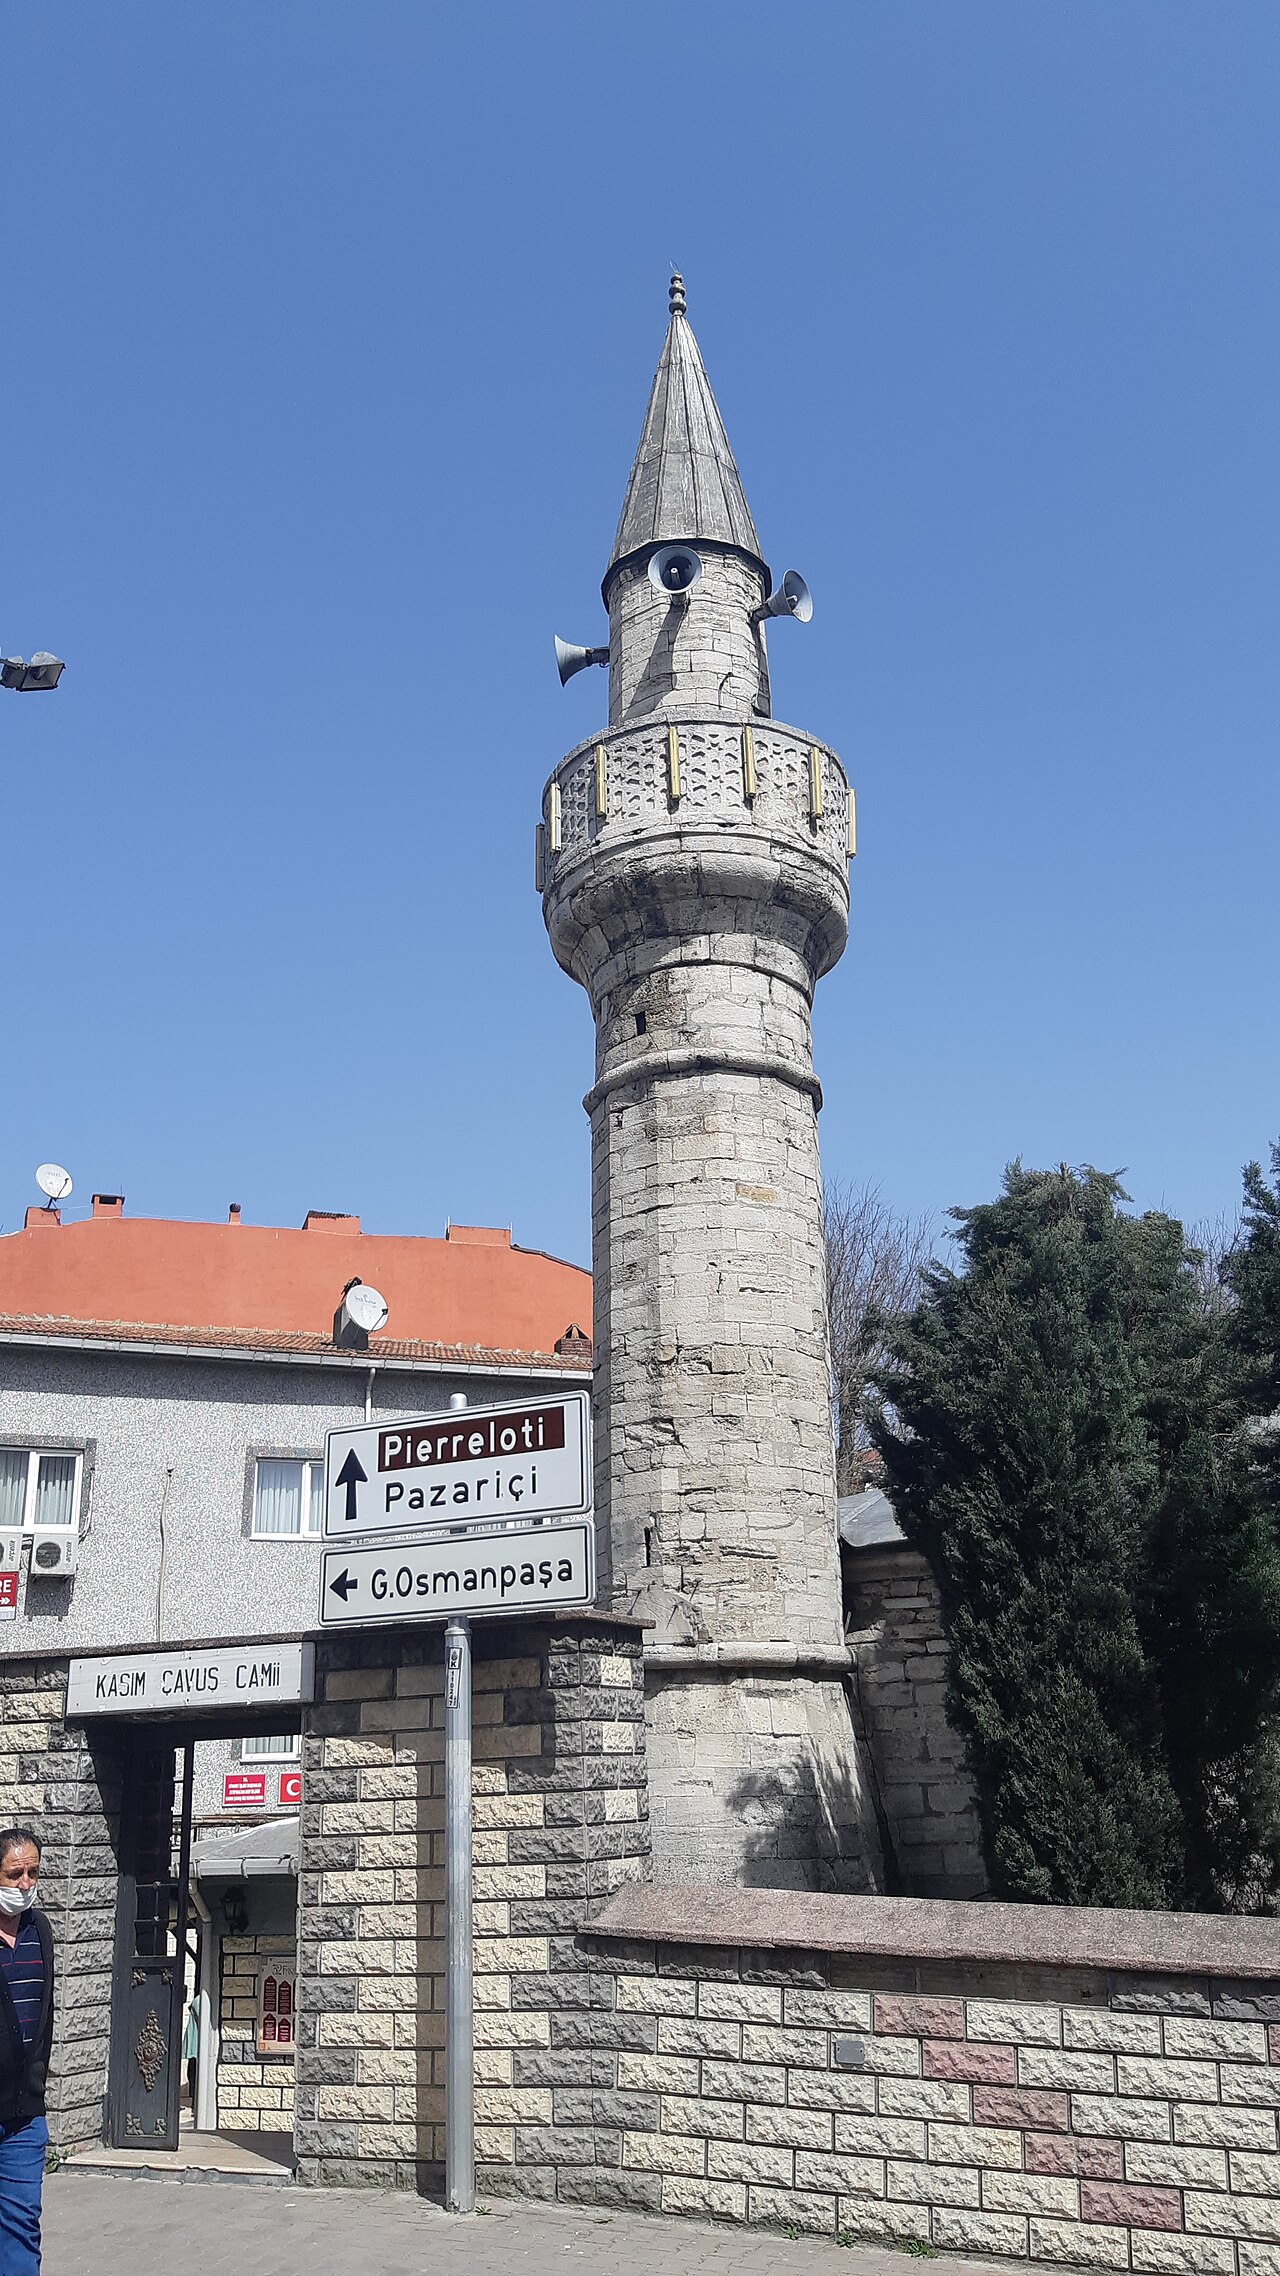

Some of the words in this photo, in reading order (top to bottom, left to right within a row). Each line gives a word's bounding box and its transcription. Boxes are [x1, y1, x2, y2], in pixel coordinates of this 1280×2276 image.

[384, 1417, 544, 1467] Pierreloti
[385, 1465, 537, 1512] Pazariçi
[65, 1541, 73, 1563] arçelik
[371, 1558, 573, 1600] G.Osmanpaşa
[95, 1672, 146, 1698] KASIM
